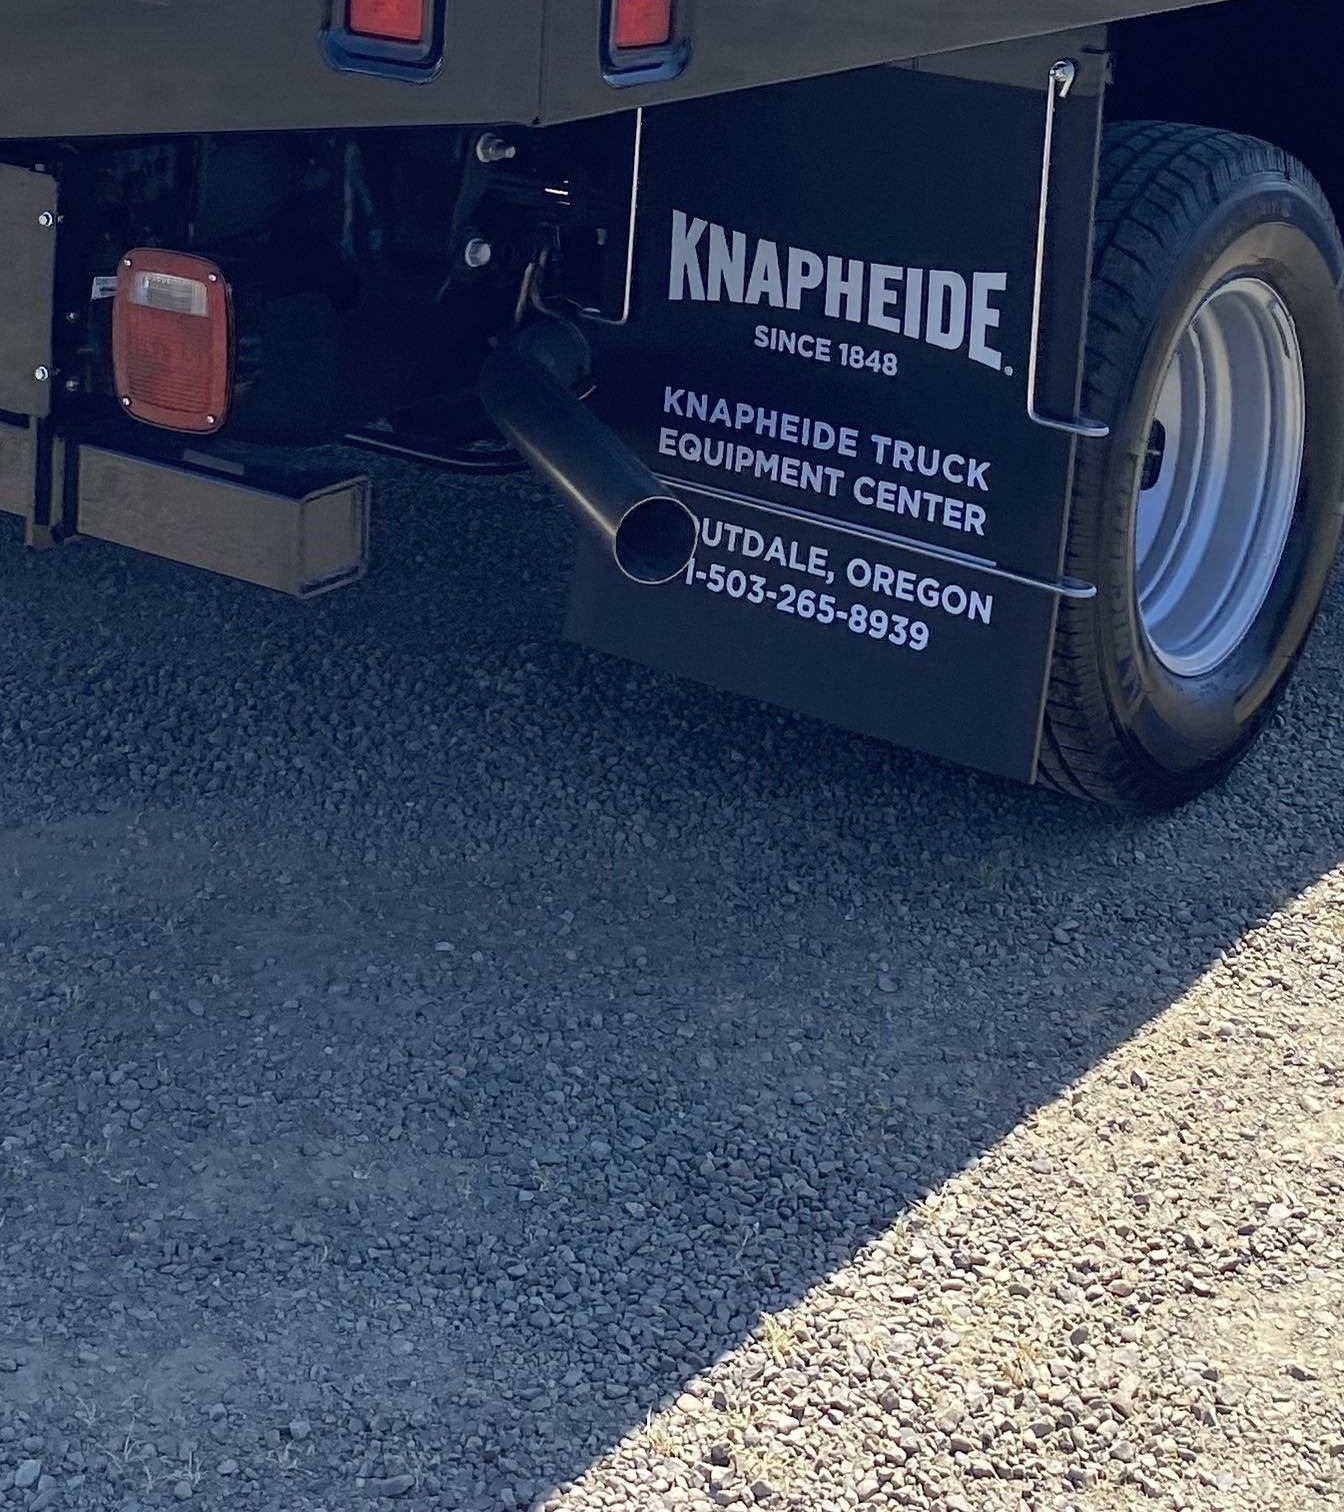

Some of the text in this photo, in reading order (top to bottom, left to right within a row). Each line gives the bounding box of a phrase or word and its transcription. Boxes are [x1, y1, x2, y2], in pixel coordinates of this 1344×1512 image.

[668, 209, 1008, 371] KNAPHEIDE
[754, 325, 898, 376] SINCE 1848
[658, 427, 987, 536] EQUIPMENT CENTER
[663, 386, 992, 492] KNAPHEIDE TRUCK
[685, 557, 930, 651] 1-503-265-8939
[696, 517, 994, 625] UTDALE, OREGON
